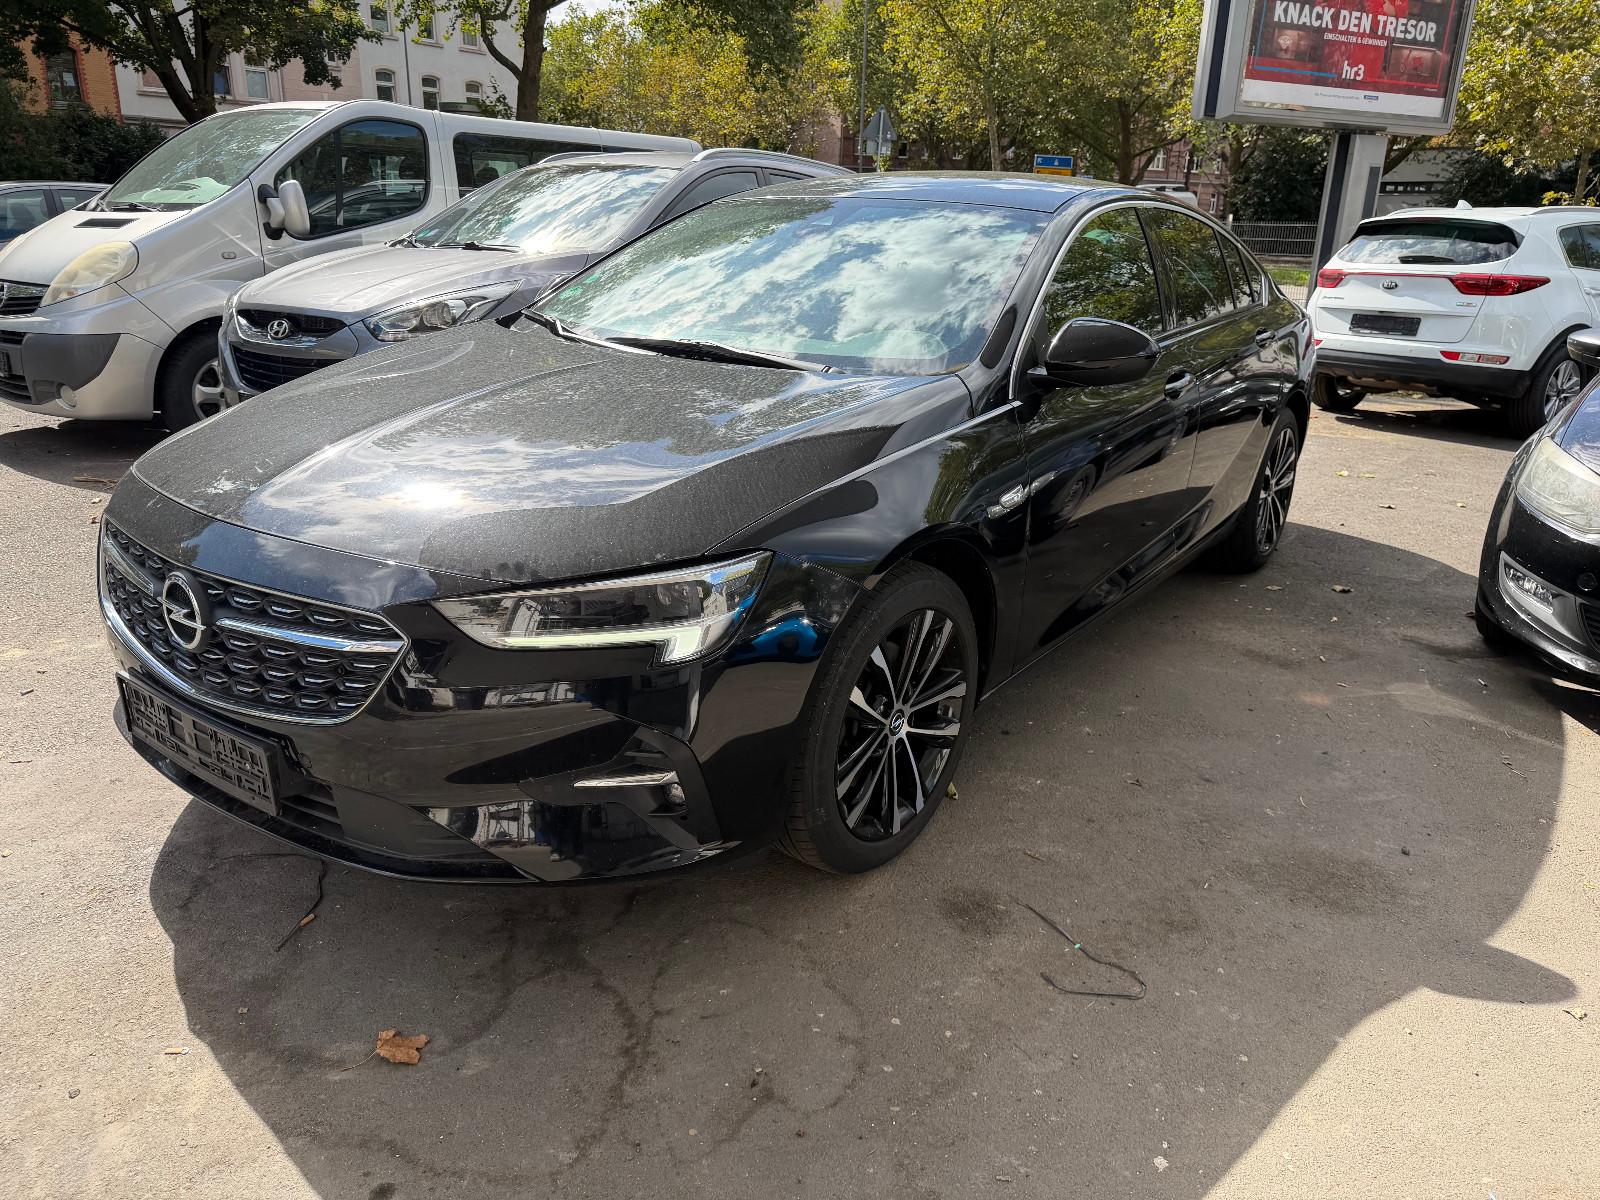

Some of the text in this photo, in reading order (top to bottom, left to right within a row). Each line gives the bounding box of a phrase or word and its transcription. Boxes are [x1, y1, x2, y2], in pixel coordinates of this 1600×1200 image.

[1273, 0, 1437, 43] KNACK DEN TRESOR
[1323, 32, 1357, 43] EINSCHALTEN
[1362, 37, 1388, 47] GEWINNEN
[1341, 60, 1365, 80] hr3
